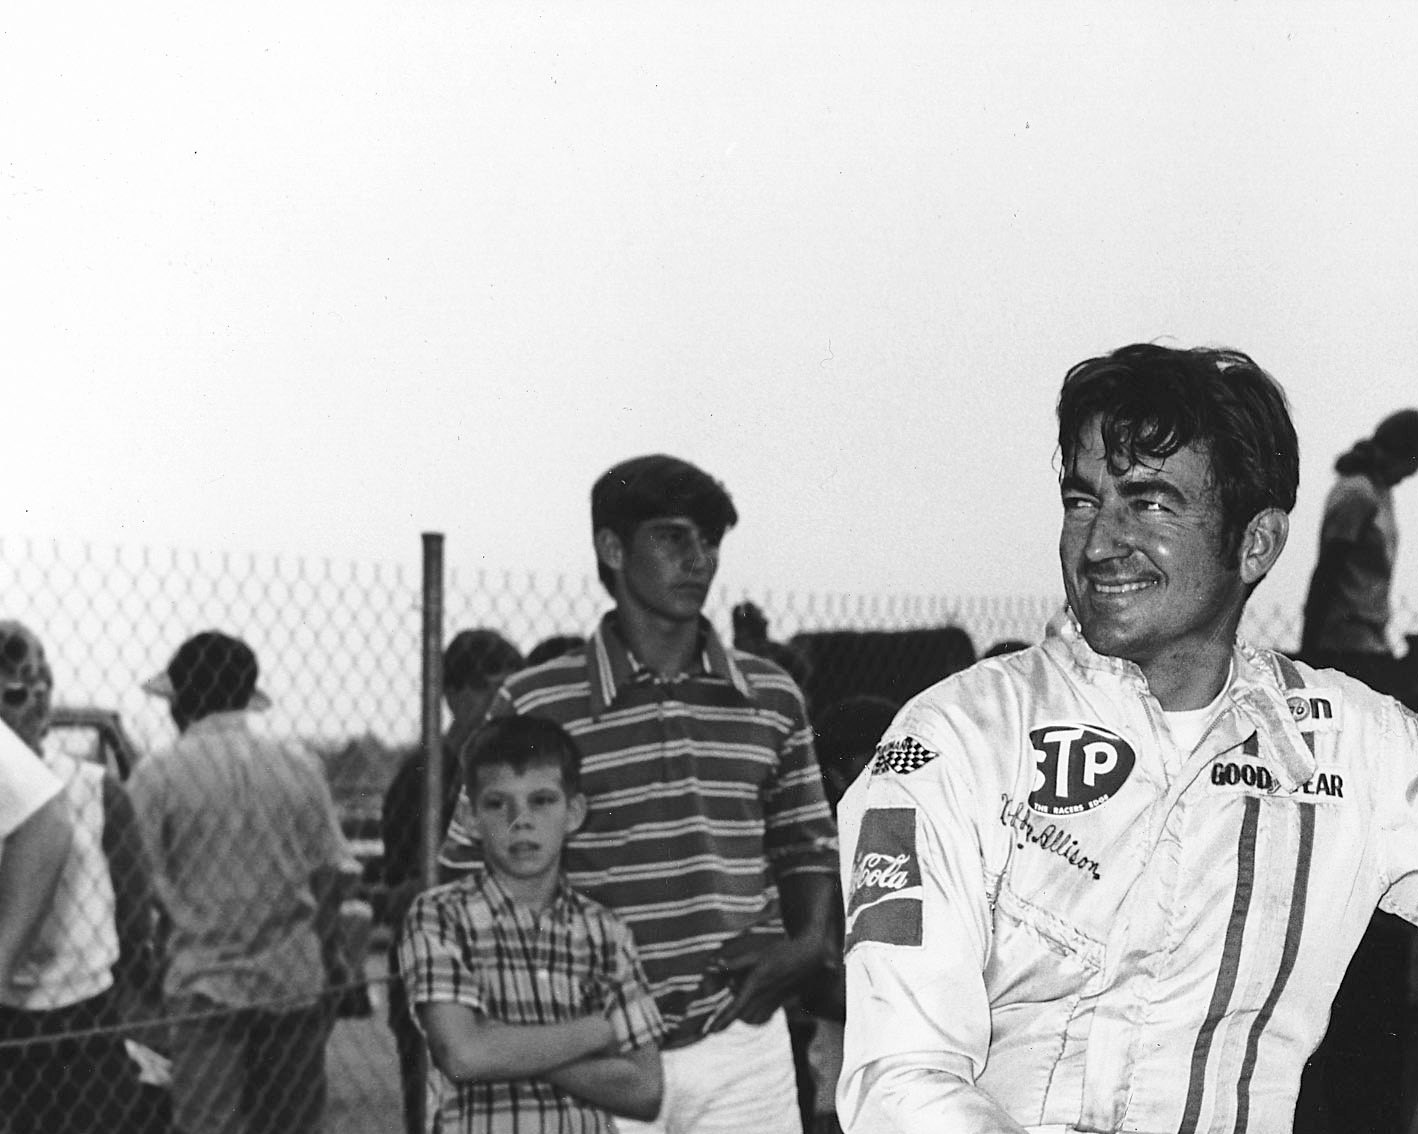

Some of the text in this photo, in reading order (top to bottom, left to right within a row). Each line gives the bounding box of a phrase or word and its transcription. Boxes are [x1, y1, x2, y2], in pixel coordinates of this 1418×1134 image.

[1211, 763, 1344, 798] GOODEAR
[1034, 802, 1049, 813] THE
[1032, 824, 1100, 880] Allison
